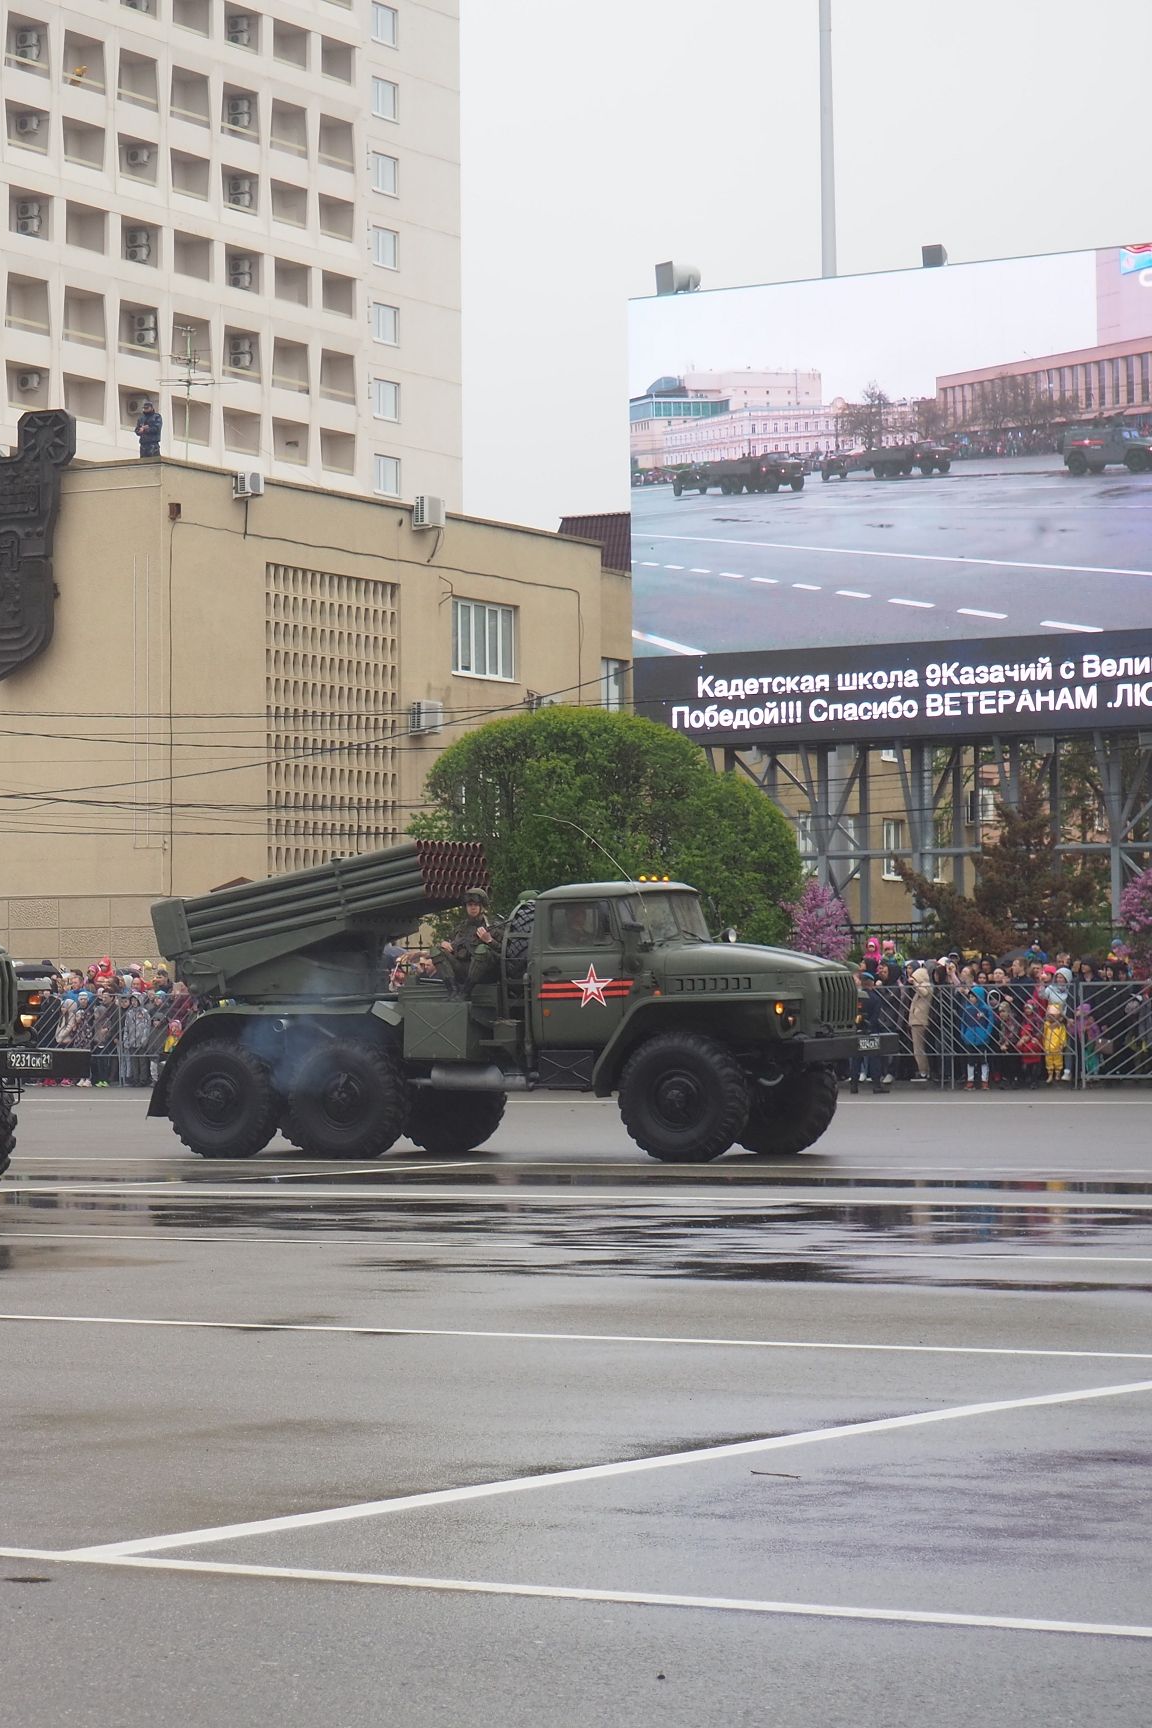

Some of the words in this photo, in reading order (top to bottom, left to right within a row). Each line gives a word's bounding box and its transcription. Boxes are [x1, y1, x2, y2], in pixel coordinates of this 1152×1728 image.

[697, 674, 830, 699] Кадетская
[837, 670, 919, 691] школа
[925, 656, 1053, 687] 9Казачий
[1059, 661, 1075, 680] с
[1082, 654, 1152, 679] Вели
[671, 700, 802, 729] Победой!!!
[808, 695, 919, 722] Спасибо
[925, 684, 1098, 717] ВЕТЕРАНАМ
